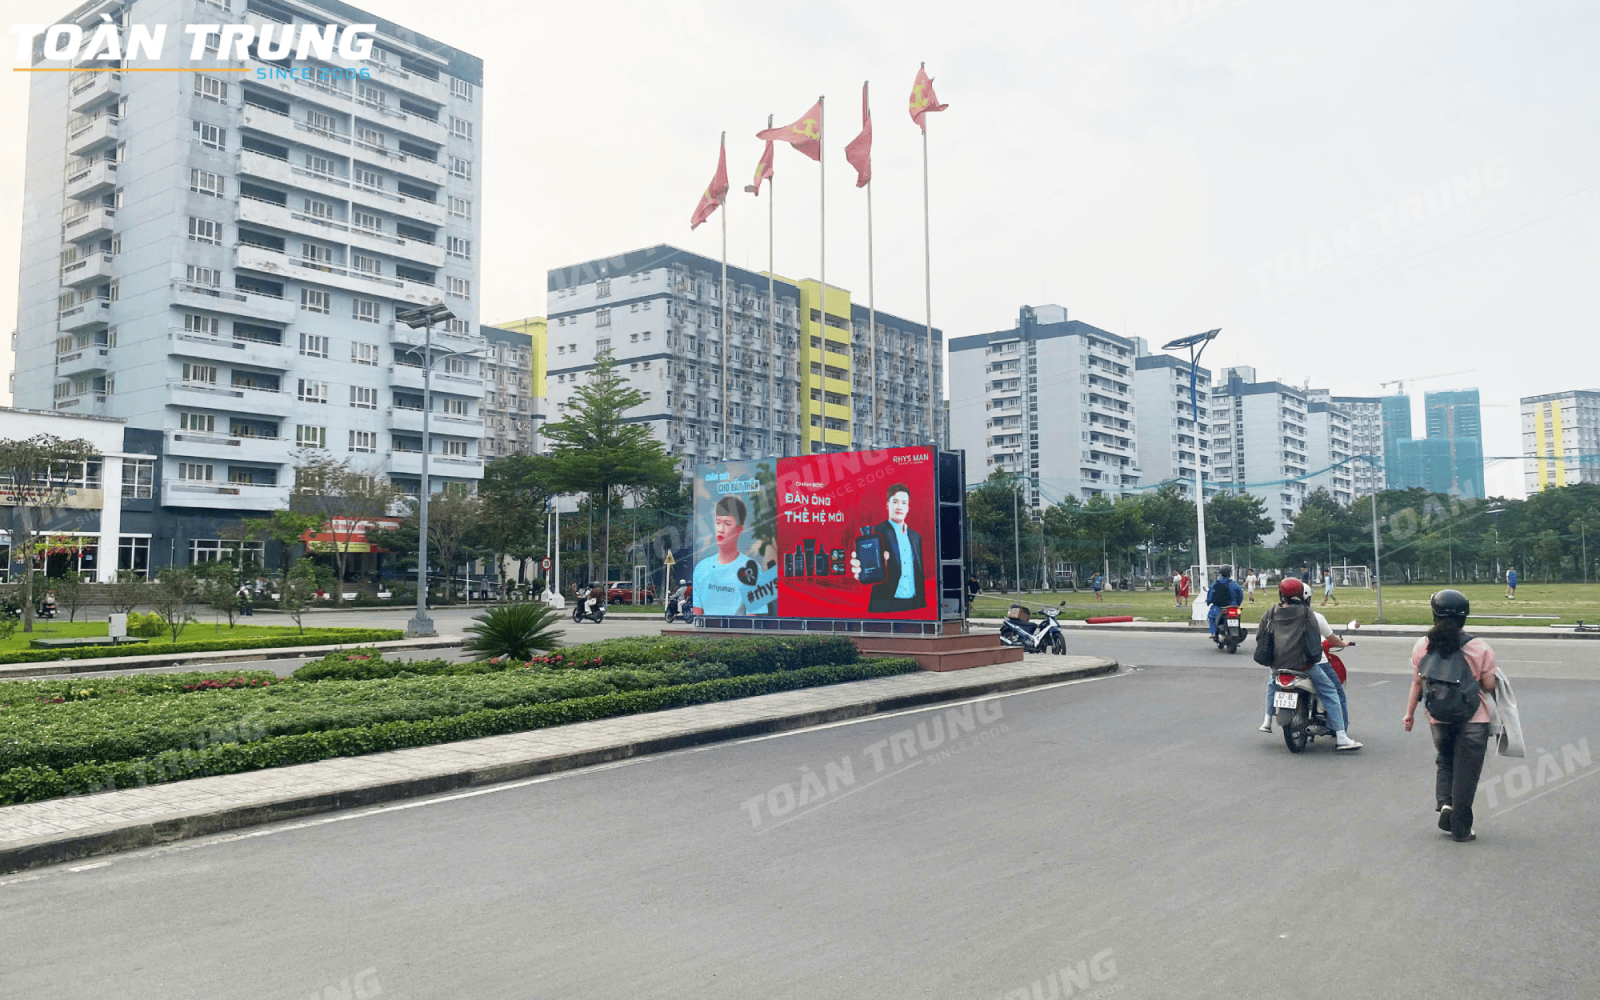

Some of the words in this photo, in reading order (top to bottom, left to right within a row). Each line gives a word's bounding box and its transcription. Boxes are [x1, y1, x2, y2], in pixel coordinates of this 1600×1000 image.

[893, 455, 911, 463] RHYS
[913, 453, 929, 461] MAN
[718, 482, 730, 493] CHO
[785, 491, 809, 504] ĐÀN
[811, 493, 831, 506] ÔNG
[785, 507, 809, 523] THẾ
[812, 509, 826, 525] HỆ
[828, 510, 844, 522] MỚI
